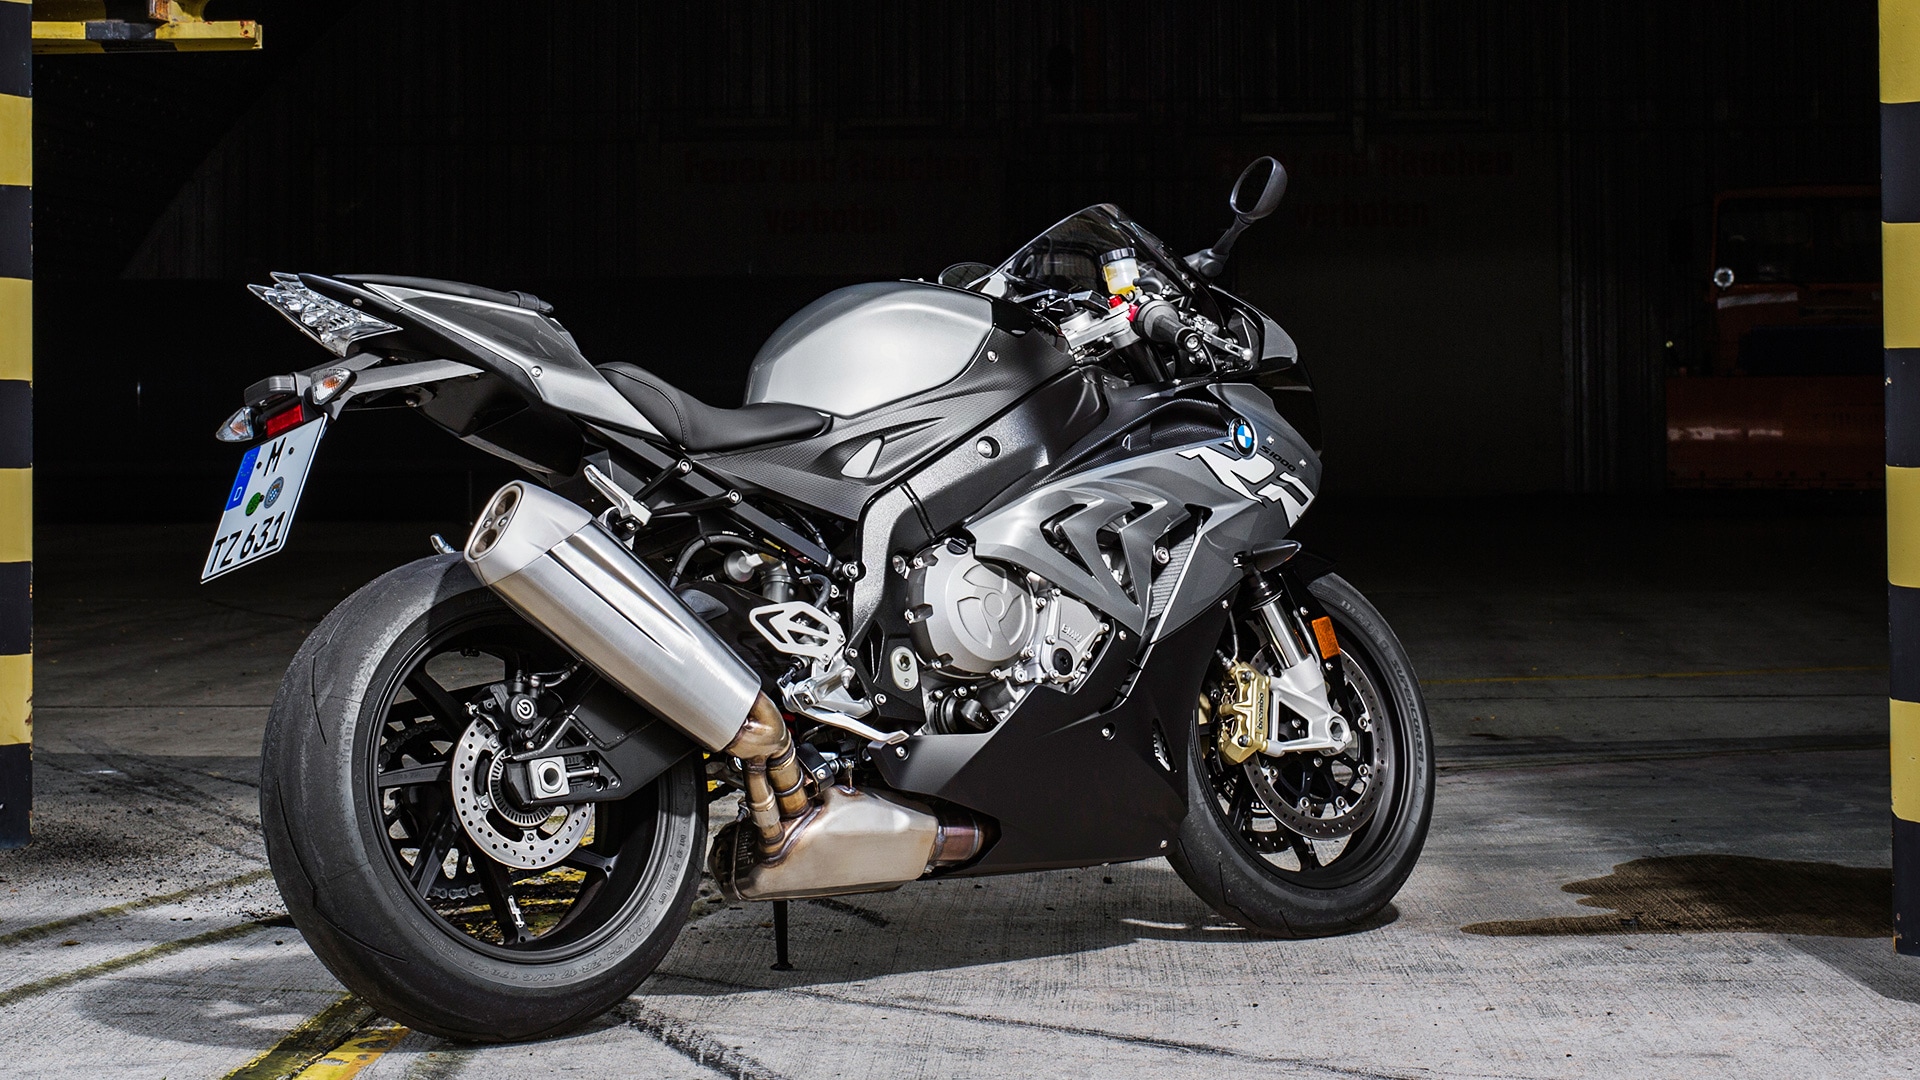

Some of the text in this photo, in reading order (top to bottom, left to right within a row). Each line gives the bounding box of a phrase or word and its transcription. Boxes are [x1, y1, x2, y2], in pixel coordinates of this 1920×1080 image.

[684, 150, 981, 185] Feuer und Rauchen
[1213, 144, 1514, 178] Fer und Rauchen
[764, 202, 898, 233] verboten
[1297, 199, 1429, 229] verboten
[263, 437, 287, 477] M
[1259, 444, 1297, 472] S1000
[233, 486, 243, 501] D
[209, 511, 286, 573] TZ 631
[1061, 623, 1083, 643] BMW
[1256, 692, 1265, 730] brembo
[1391, 658, 1424, 763] SUPERCORSA
